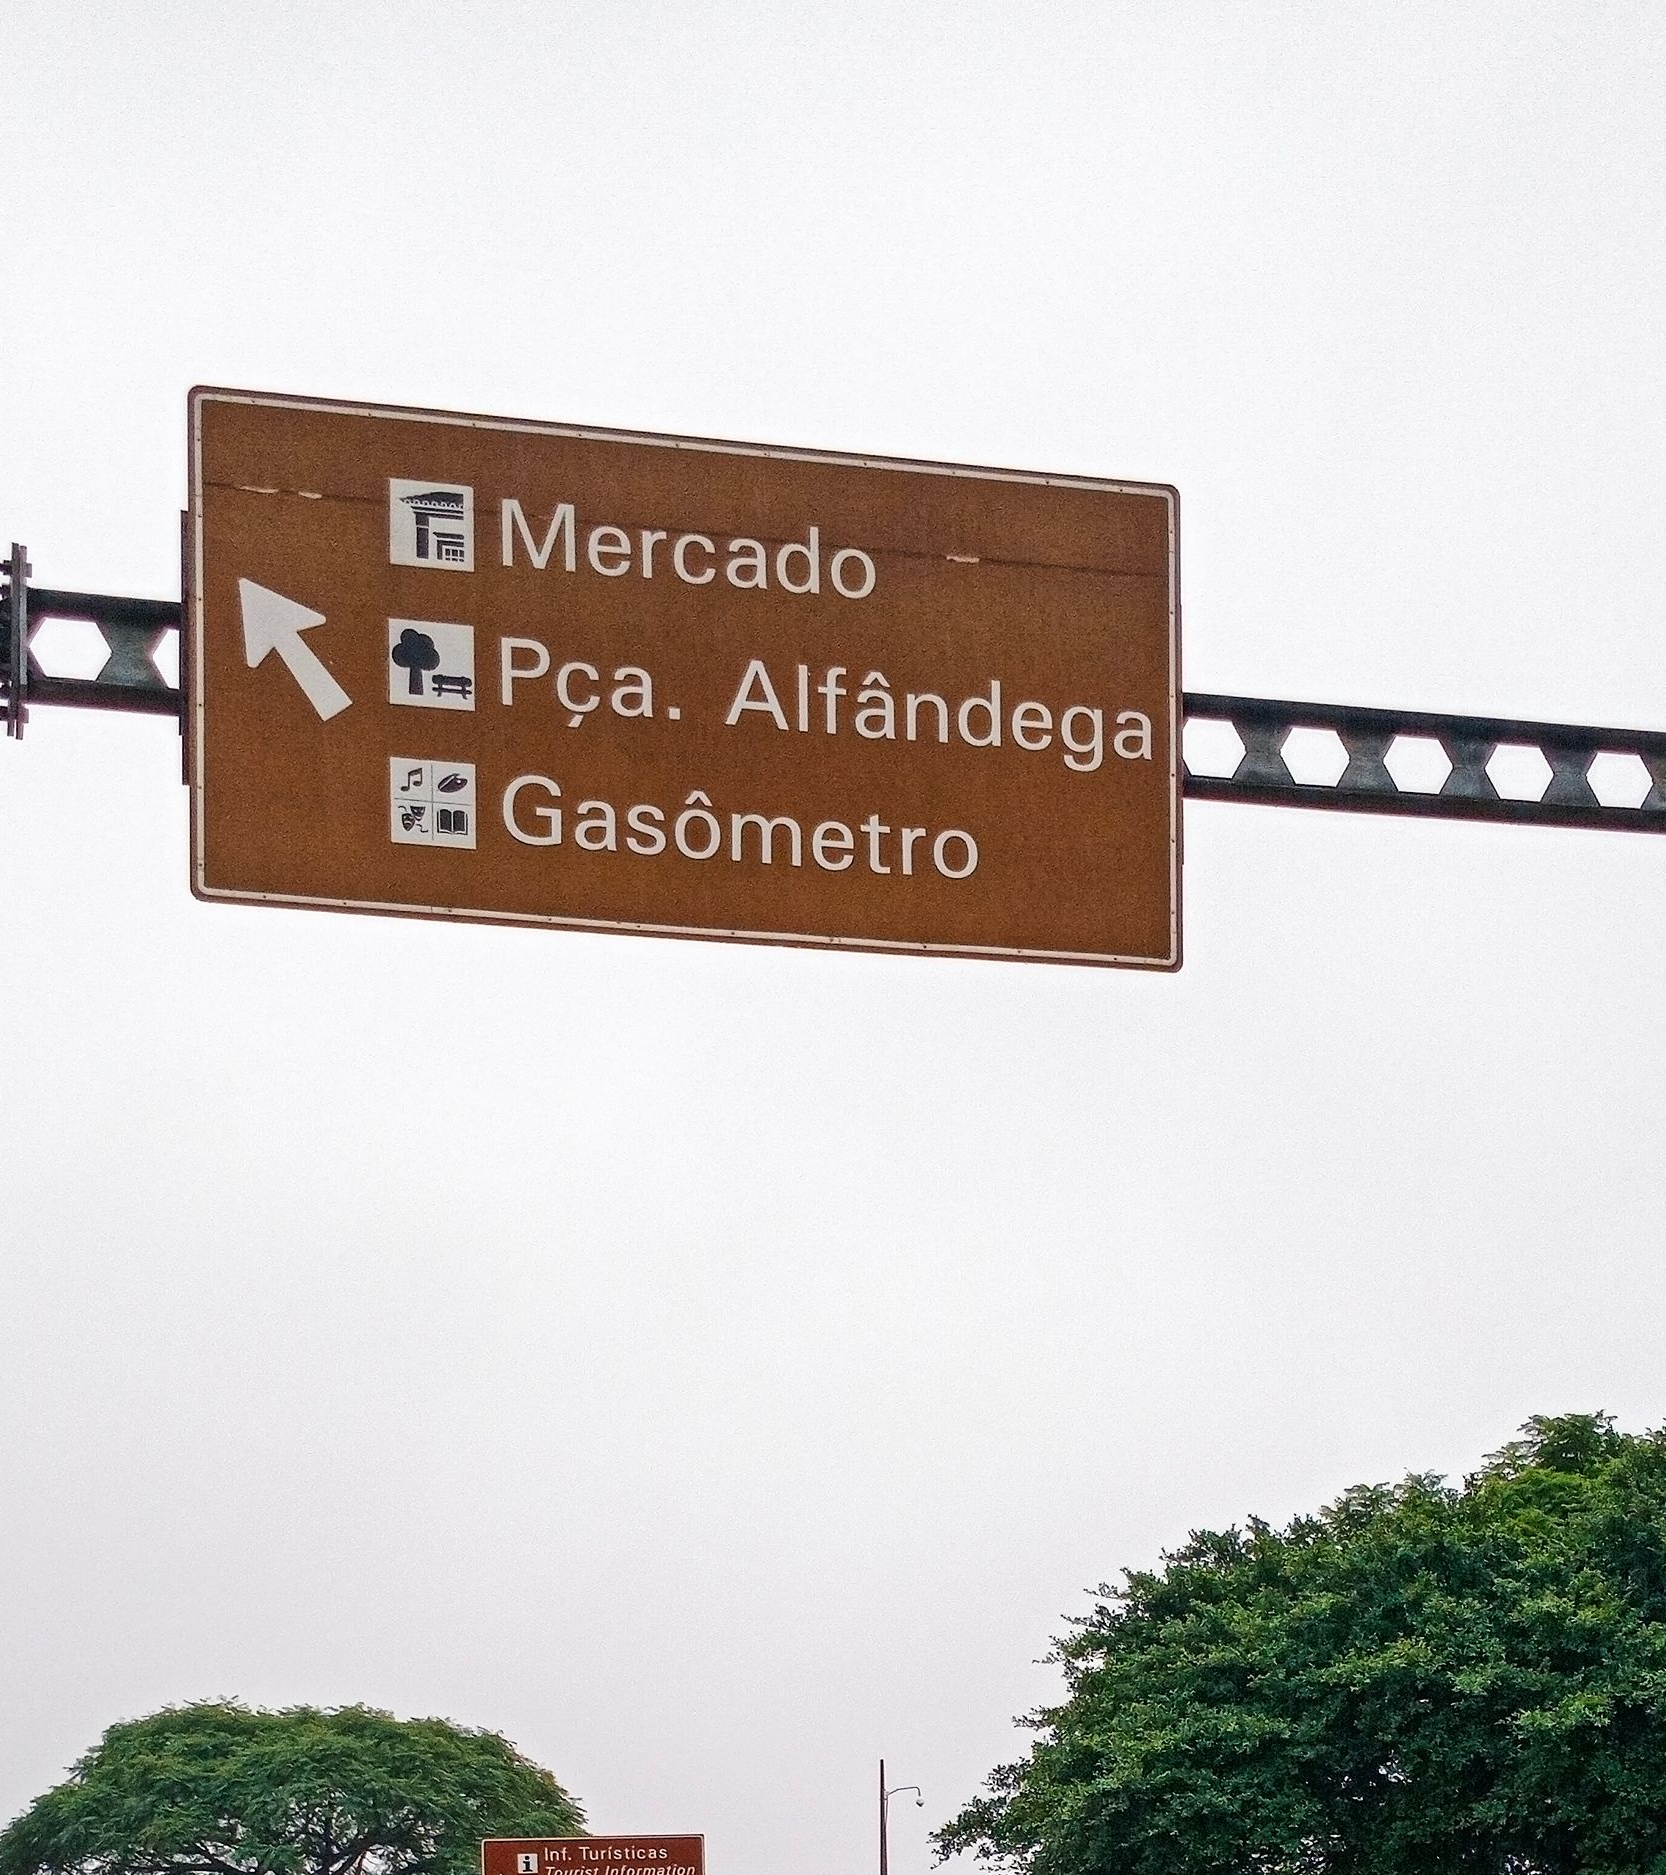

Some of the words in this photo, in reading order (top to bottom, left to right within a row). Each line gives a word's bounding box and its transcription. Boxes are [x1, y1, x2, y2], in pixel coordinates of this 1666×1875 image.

[499, 499, 877, 602] Mercado
[499, 635, 682, 728] Pça.
[726, 659, 1154, 774] Alfândega
[501, 773, 980, 881] Gasômetro
[544, 1847, 572, 1861] Inf.
[578, 1845, 668, 1861] Turísticas
